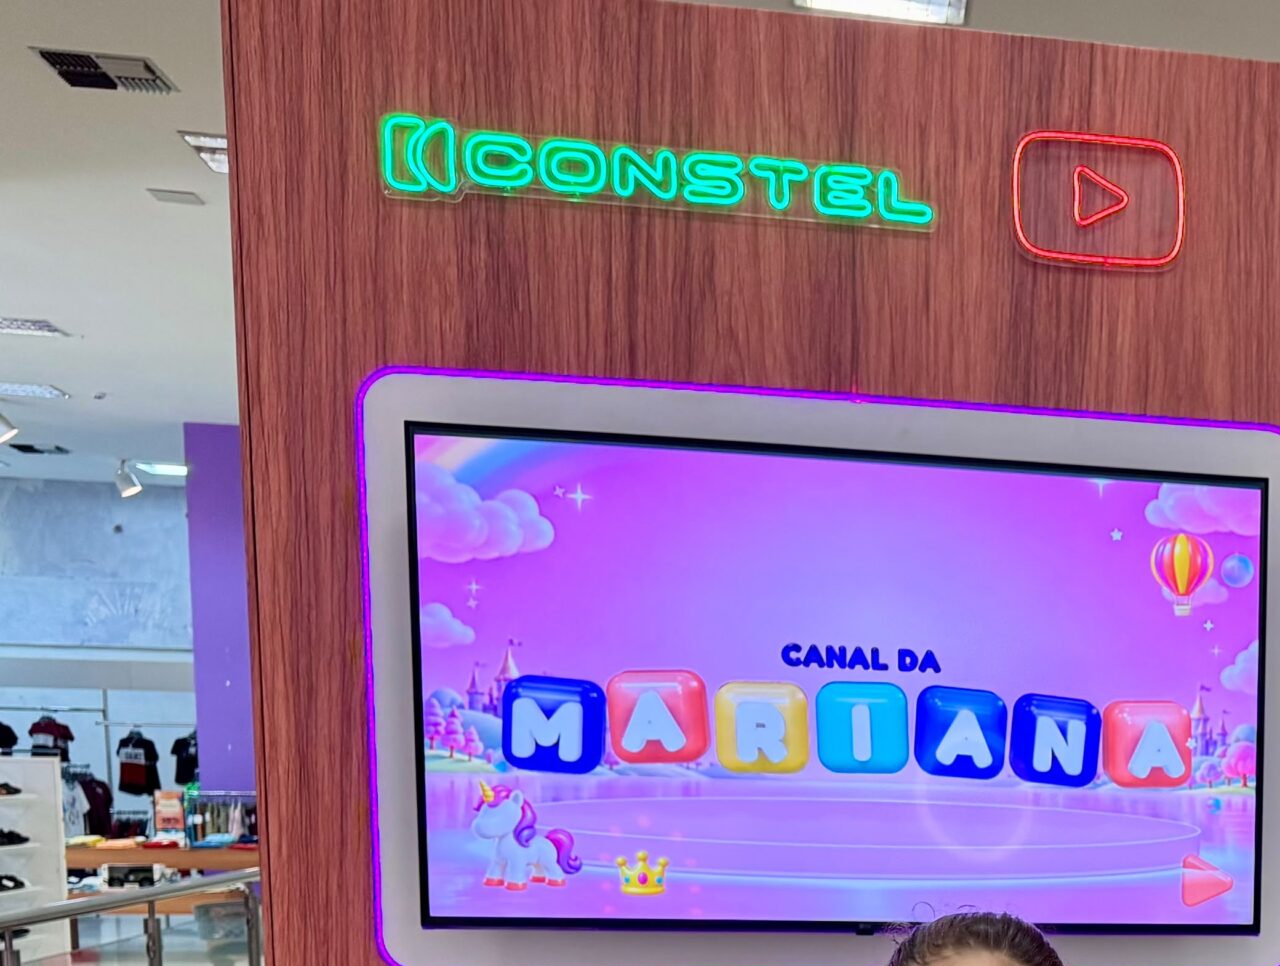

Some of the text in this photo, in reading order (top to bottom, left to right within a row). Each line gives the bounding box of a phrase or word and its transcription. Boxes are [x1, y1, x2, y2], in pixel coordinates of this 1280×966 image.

[463, 132, 934, 226] CONSTEL
[780, 641, 943, 675] CANAL DA
[508, 687, 1191, 780] MARIANA
